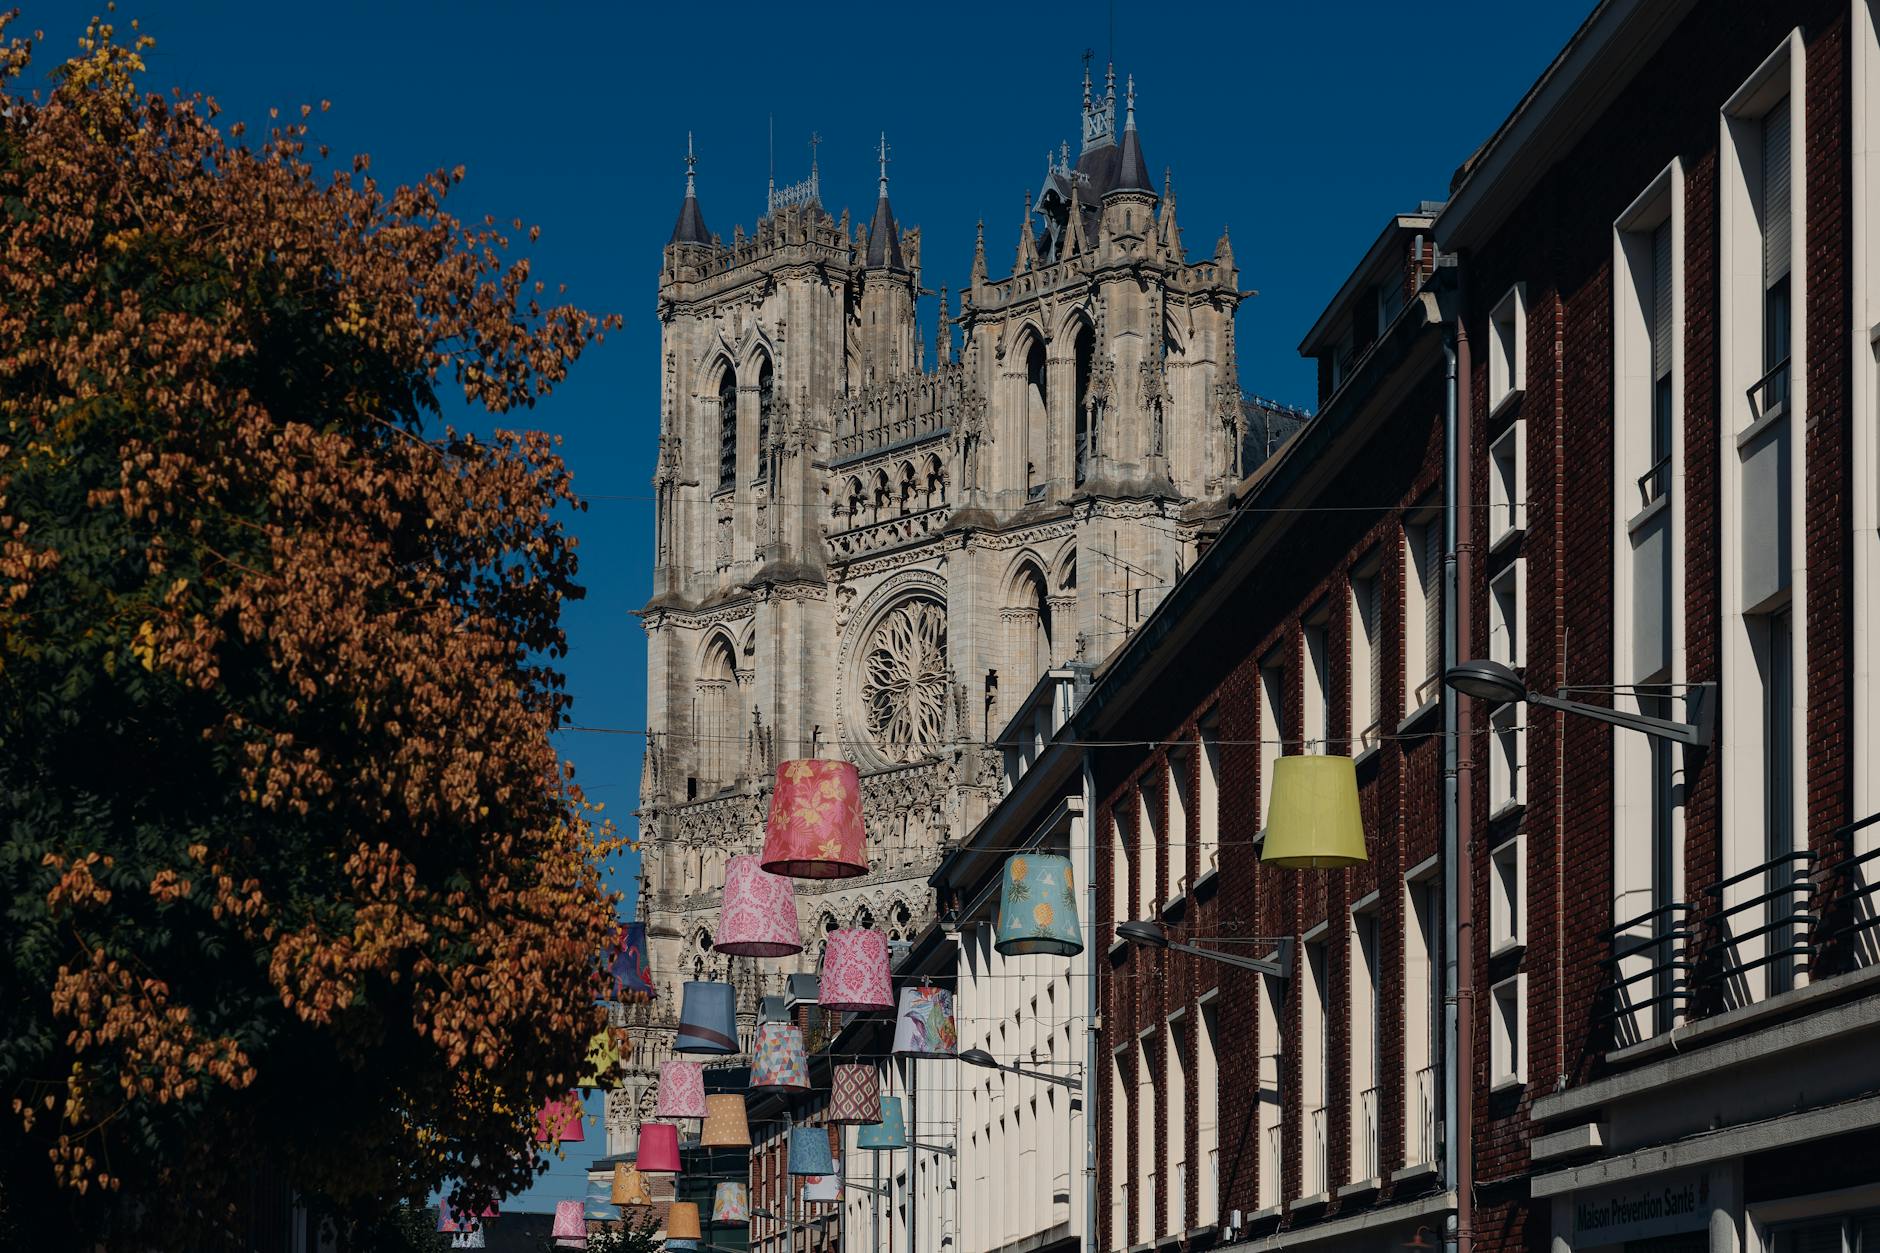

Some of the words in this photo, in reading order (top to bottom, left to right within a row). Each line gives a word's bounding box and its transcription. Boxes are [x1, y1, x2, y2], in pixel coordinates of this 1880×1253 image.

[1577, 1204, 1610, 1231] Maison
[1611, 1194, 1663, 1225] Prévention
[1664, 1184, 1695, 1216] Santé
